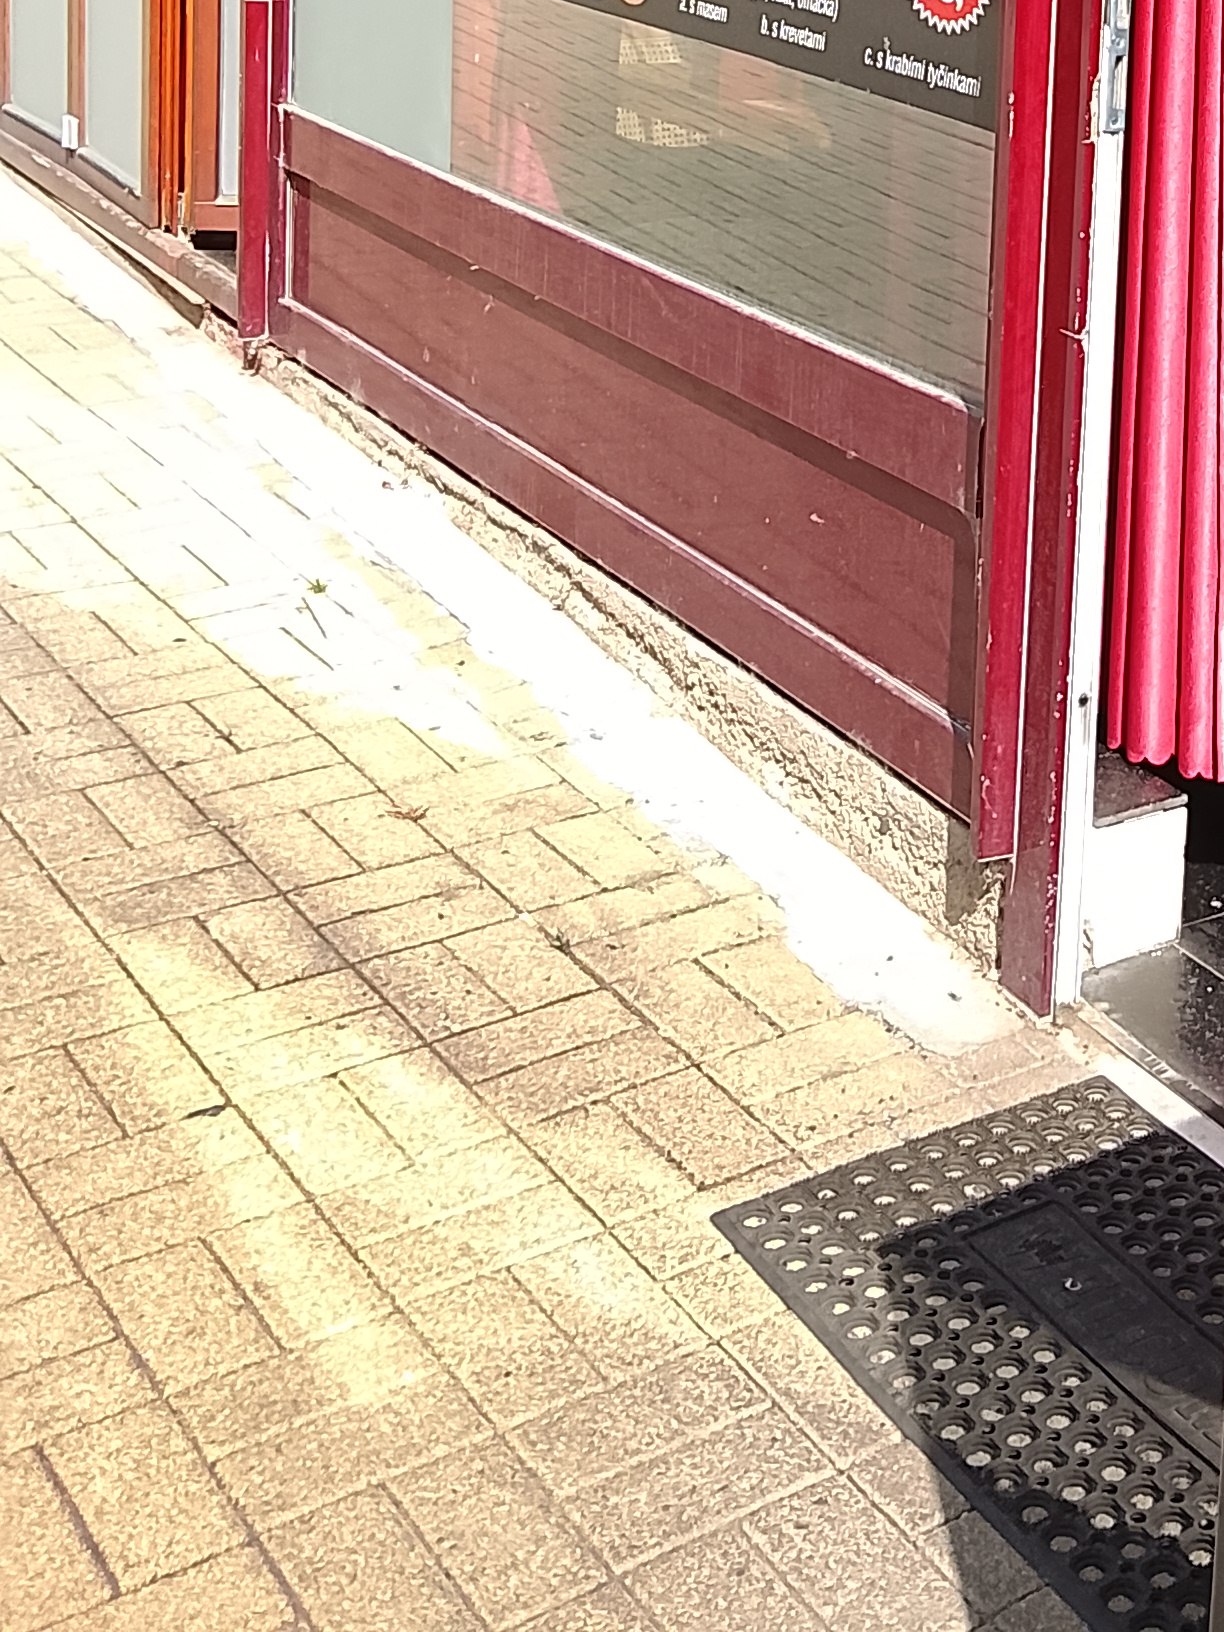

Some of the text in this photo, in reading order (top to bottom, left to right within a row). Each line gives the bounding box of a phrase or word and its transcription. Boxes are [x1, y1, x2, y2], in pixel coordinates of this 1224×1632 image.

[771, 21, 779, 39] s
[779, 19, 828, 52] krevetami
[876, 50, 884, 69] s
